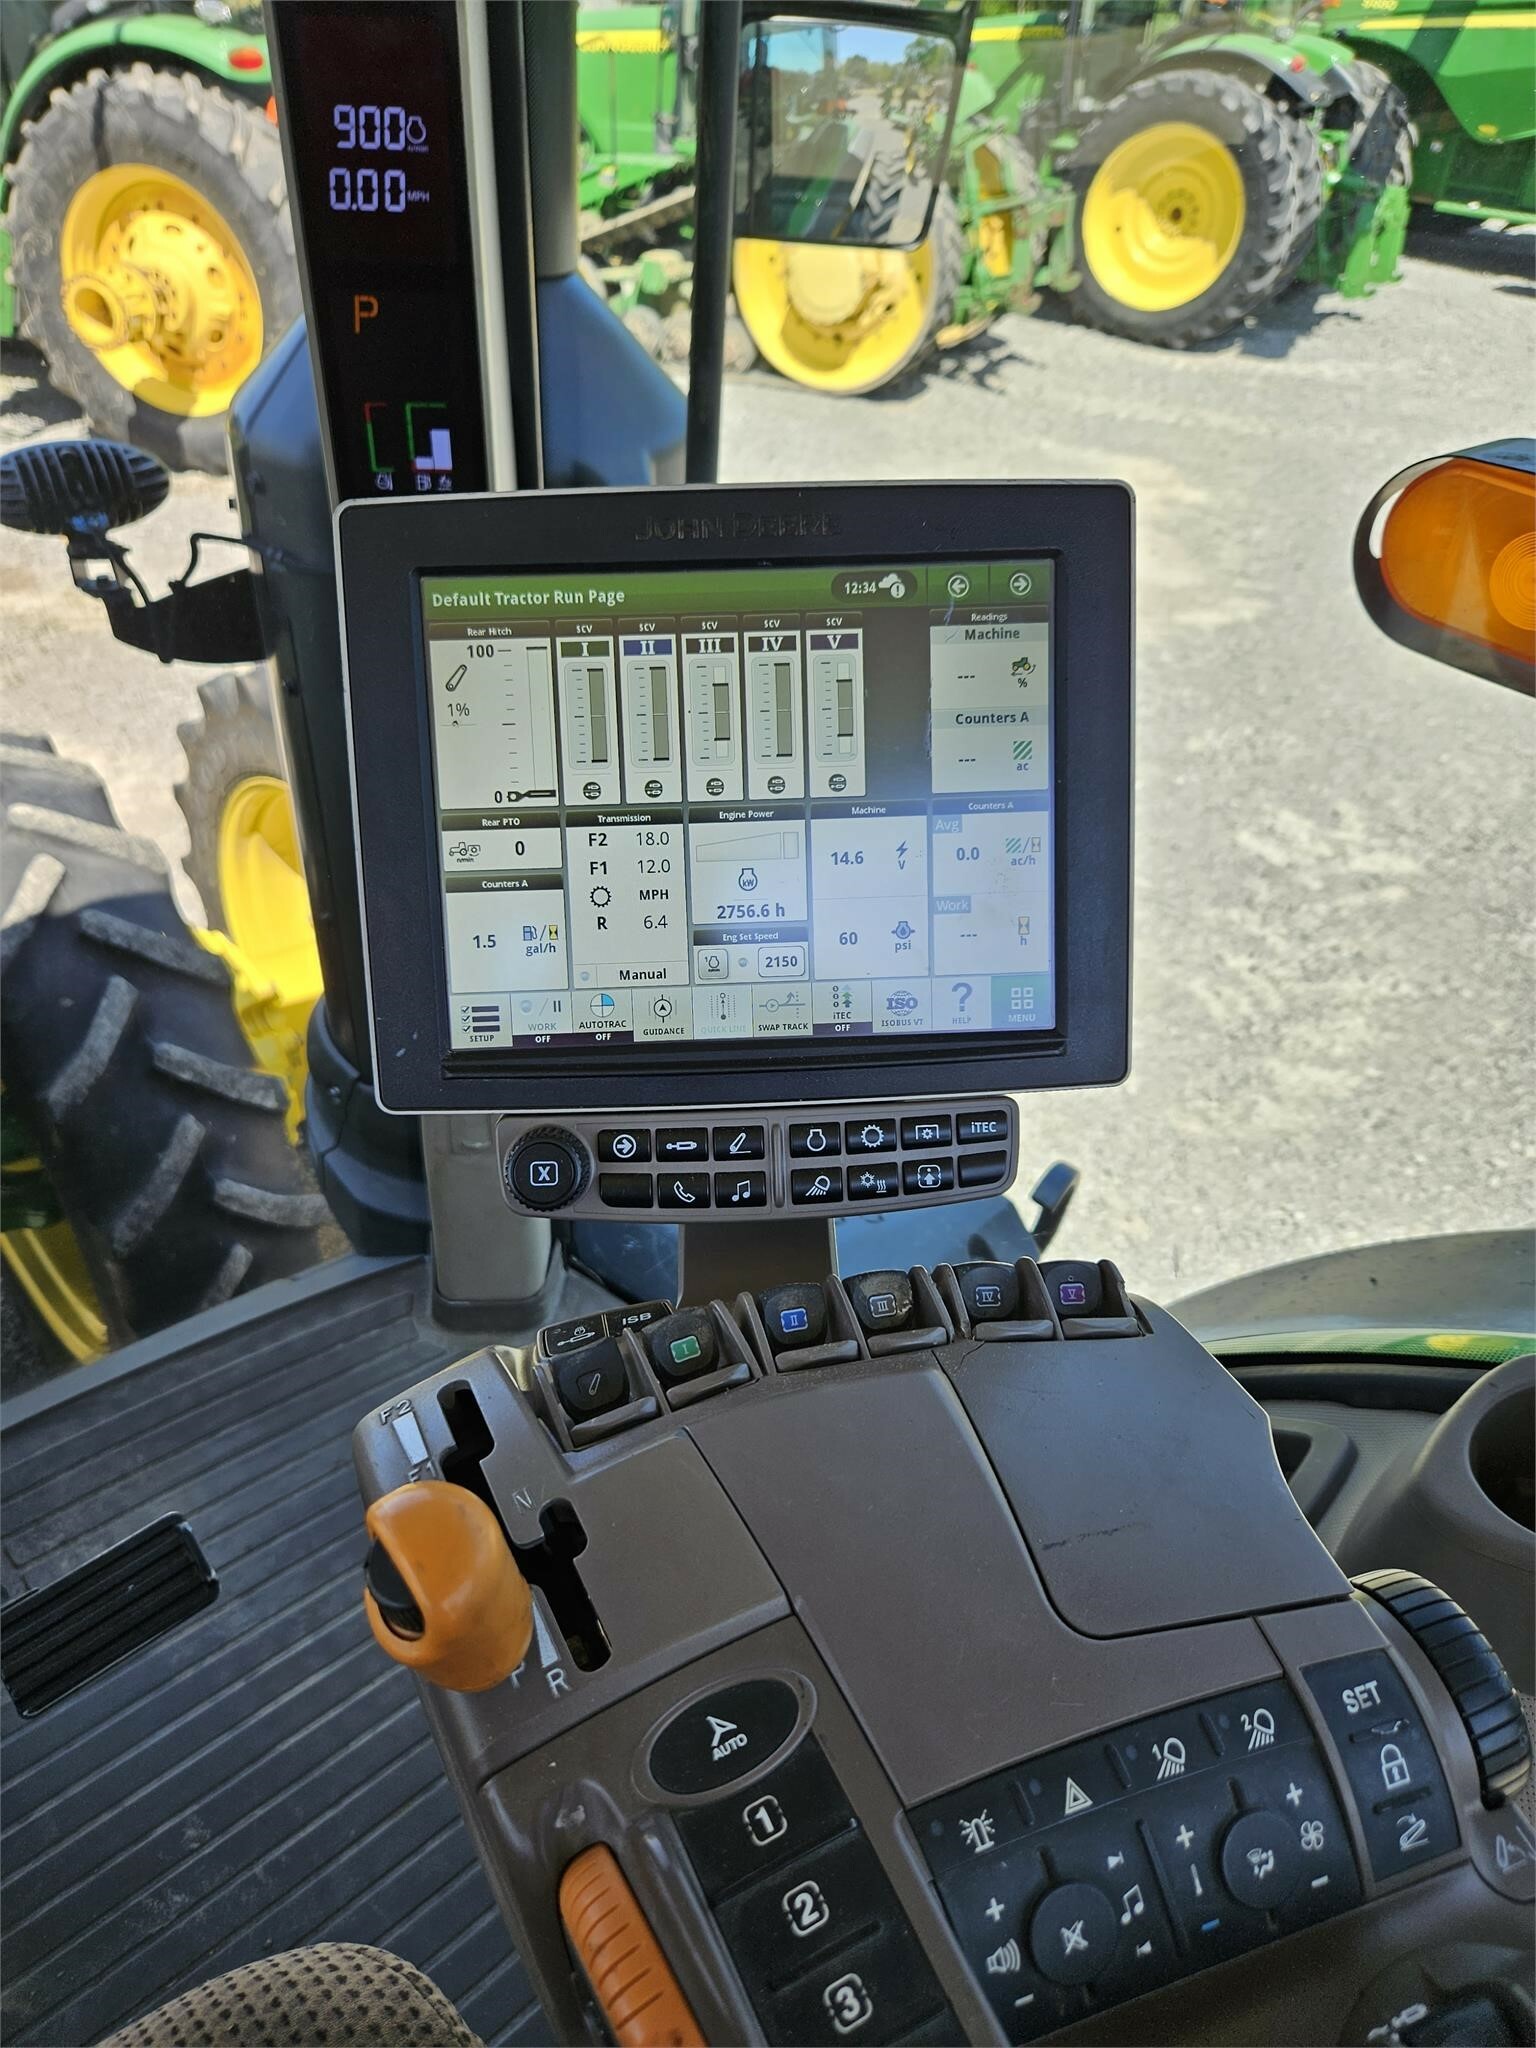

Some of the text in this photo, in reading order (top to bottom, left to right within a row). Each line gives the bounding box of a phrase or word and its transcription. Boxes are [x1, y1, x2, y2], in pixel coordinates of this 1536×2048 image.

[333, 104, 406, 151] 900
[328, 167, 406, 213] 0.00
[354, 294, 379, 334] P
[844, 581, 877, 594] 12:34
[432, 588, 625, 608] Default Tractor Run Page
[763, 619, 780, 629] SCV
[826, 617, 843, 626] SCV
[970, 612, 1008, 624] Readings
[466, 625, 512, 637] Rear Hitch
[576, 624, 593, 634] SCV
[639, 622, 656, 633] SCV
[701, 620, 718, 631] SCV
[964, 627, 1020, 641] Machine
[639, 640, 656, 655] II
[698, 638, 721, 653] III
[761, 636, 784, 651] IV
[826, 634, 842, 649] V
[466, 644, 495, 659] 100
[1017, 677, 1028, 688] %
[447, 702, 471, 717] 1%
[955, 712, 1030, 725] Counters A
[1016, 762, 1029, 771] ac
[494, 790, 503, 803] 0
[851, 805, 886, 815] Machine
[967, 801, 1014, 811] Counters A
[481, 817, 521, 827] Rear PTO
[597, 813, 651, 823] Transmission
[719, 810, 775, 821] Engine Power
[934, 819, 960, 833] Avg
[588, 831, 670, 847] F2 18.0
[515, 840, 525, 856] 0
[956, 847, 980, 862] 0.0
[830, 851, 864, 866] 14.6
[897, 859, 906, 870] V
[1010, 855, 1036, 866] ac/h
[589, 859, 671, 875] F1 12.0
[481, 879, 529, 889] Counters A
[742, 879, 755, 888] kW
[639, 889, 669, 901] MPH
[717, 902, 786, 920] 2756.6 h
[936, 899, 969, 912] Work
[597, 914, 668, 931] R 6.4
[472, 934, 497, 949] 1.5
[722, 931, 779, 942] Eng Set Speed
[839, 932, 858, 945] 60
[1020, 935, 1027, 946] h
[525, 943, 557, 957] gal/h
[894, 940, 912, 952] psi
[765, 955, 798, 968] 2150
[618, 968, 667, 981] Manual
[886, 996, 919, 1010] ISO
[832, 1011, 852, 1020] iTEC
[951, 1015, 972, 1025] HELP
[1008, 1012, 1036, 1023] MENU
[527, 1022, 557, 1031] WORK
[578, 1019, 627, 1030] AUTOTRAC
[758, 1022, 809, 1032] SWAP TRACK
[834, 1024, 851, 1032] OFF
[881, 1018, 924, 1027] ISOBUS VT
[595, 1032, 612, 1042] OFF
[643, 1026, 685, 1036] GUIDANCE
[469, 1033, 495, 1043] SETUP
[534, 1034, 551, 1044] OFF
[970, 1120, 997, 1134] iTEC
[380, 1399, 413, 1425] F2
[511, 1487, 536, 1514] N
[546, 1668, 572, 1699] R
[1341, 1679, 1381, 1714] SET
[1240, 1713, 1253, 1732] 2
[712, 1732, 748, 1761] AUTO
[754, 1805, 774, 1833] 1
[794, 1891, 820, 1927] 2
[835, 1986, 861, 2021] 3
